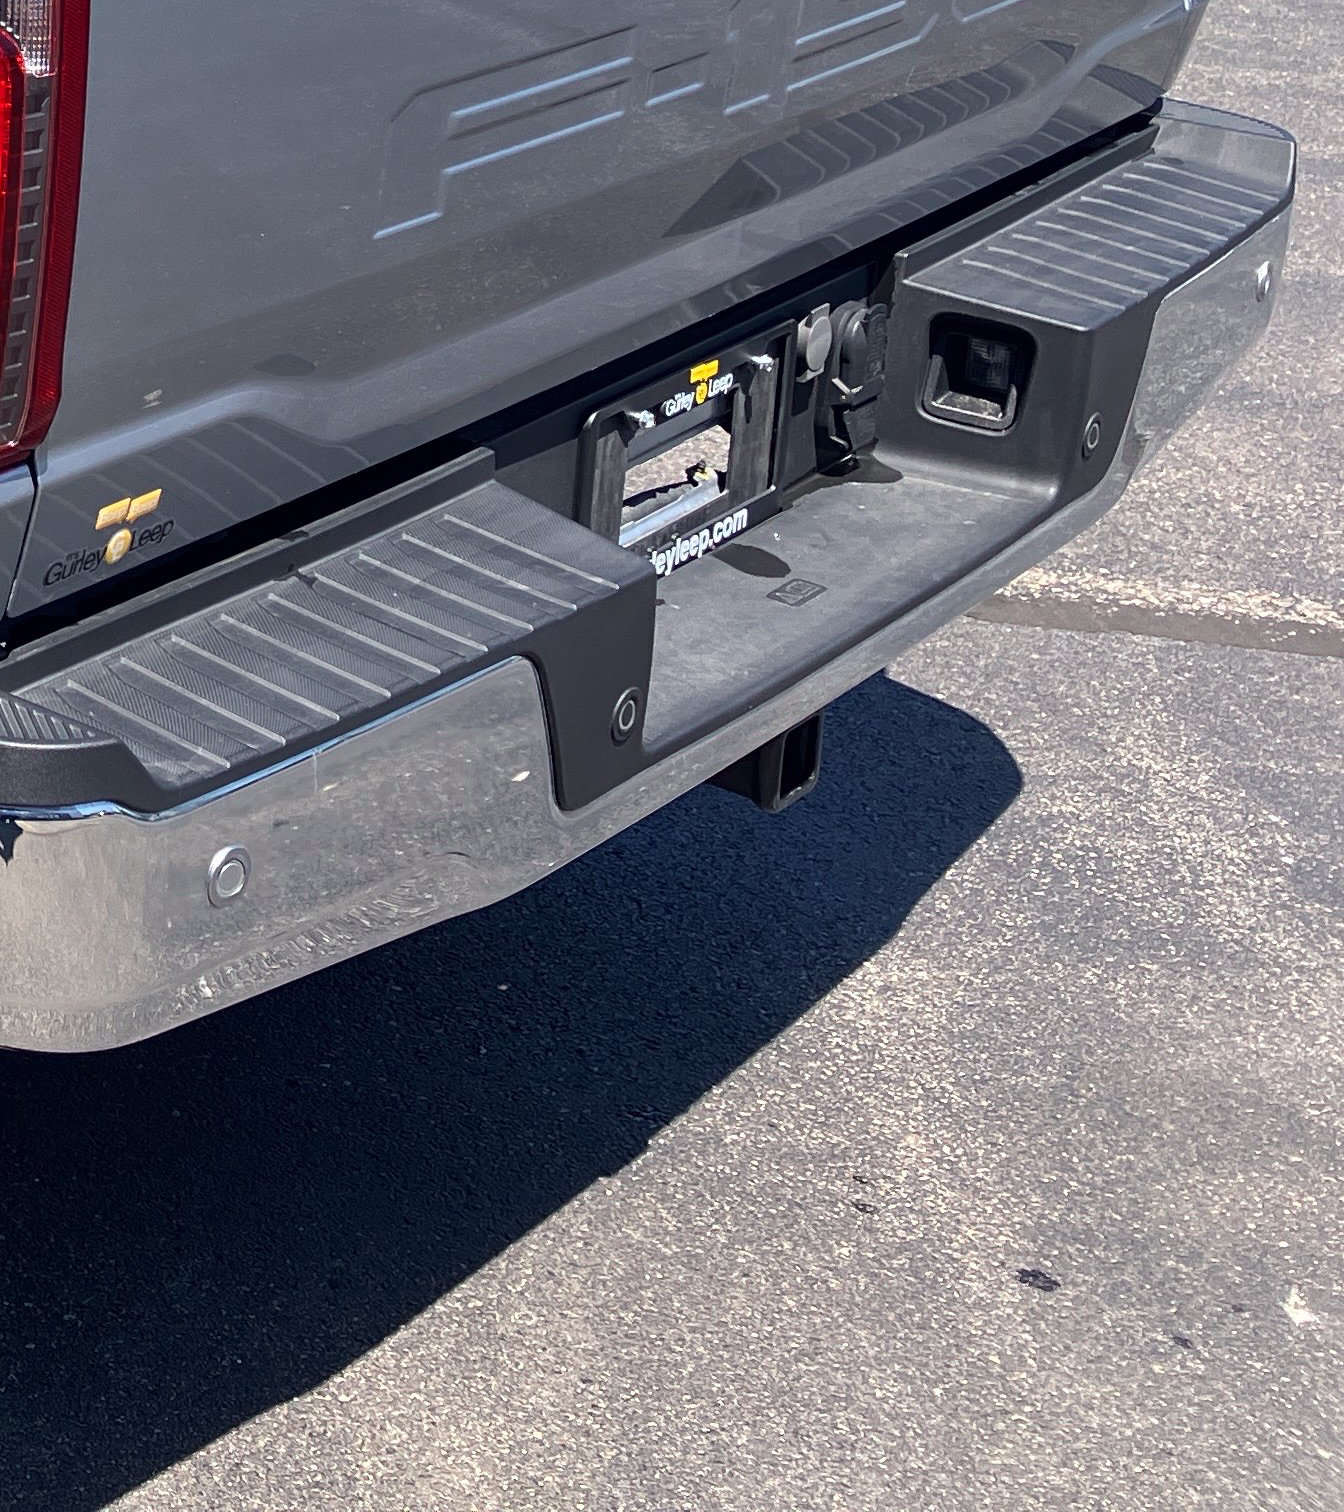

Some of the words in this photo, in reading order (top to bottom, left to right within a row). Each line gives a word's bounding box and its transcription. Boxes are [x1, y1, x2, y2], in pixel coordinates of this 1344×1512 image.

[708, 373, 733, 398] Leep
[42, 543, 108, 586] Gurley
[128, 519, 174, 553] Leep
[649, 508, 748, 576] leyleep.com
